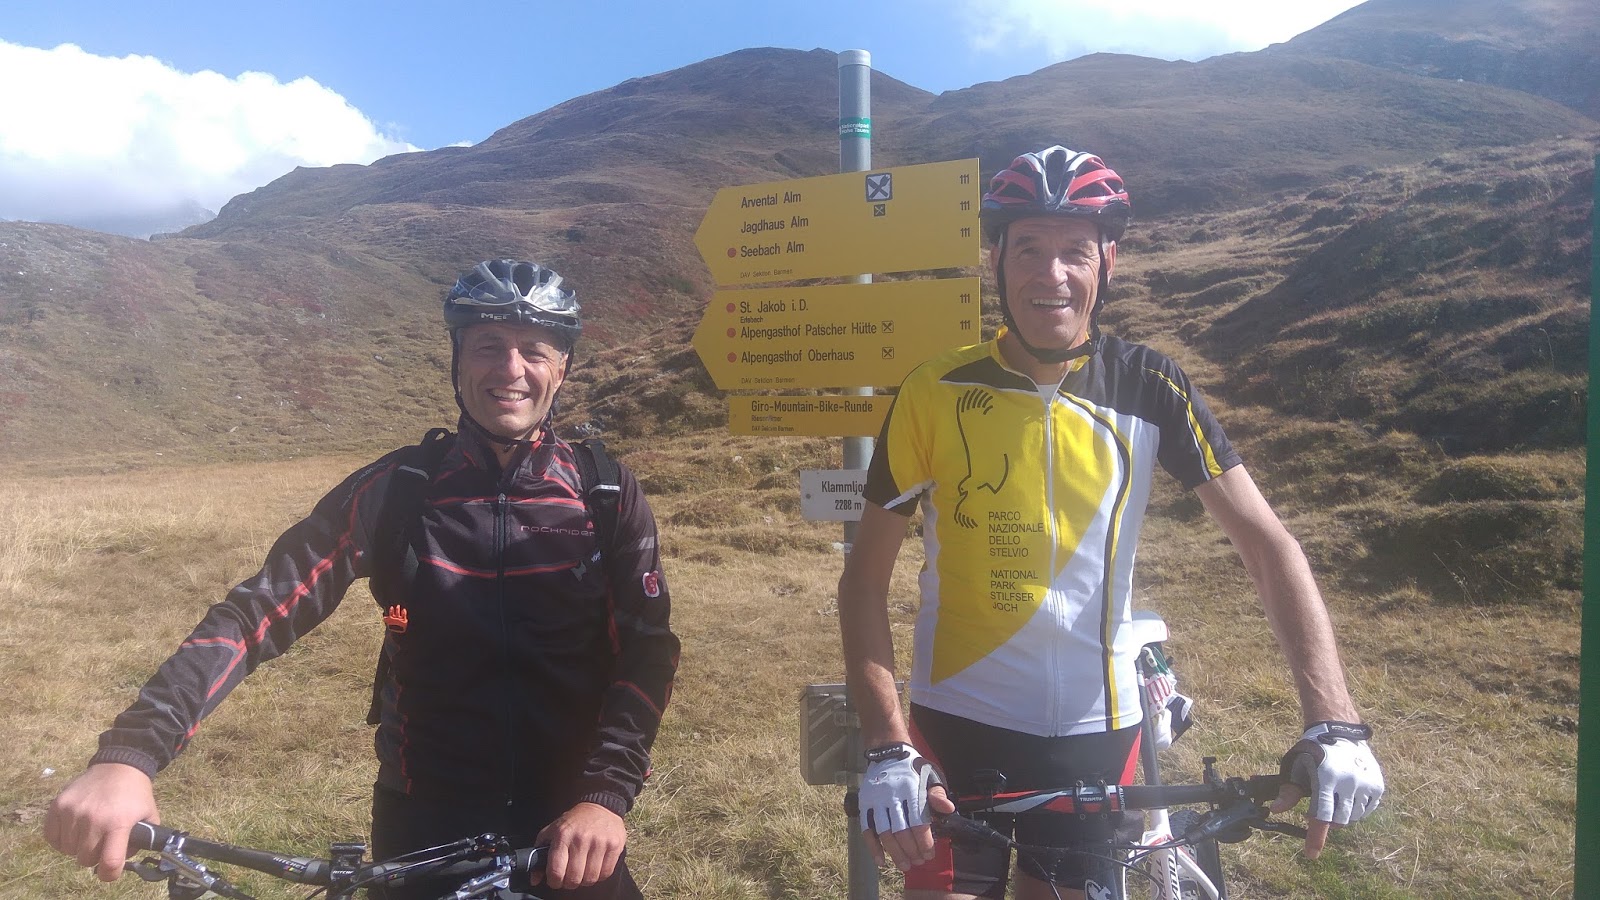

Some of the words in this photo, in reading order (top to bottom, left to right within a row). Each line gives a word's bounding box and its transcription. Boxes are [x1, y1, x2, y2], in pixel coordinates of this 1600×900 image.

[741, 193, 778, 209] Arvental
[783, 191, 802, 204] Alm
[959, 173, 970, 185] 111
[740, 219, 785, 235] Jagdhaus
[790, 215, 809, 229] Alm
[959, 200, 970, 211] 111
[740, 242, 781, 258] Seebach
[786, 241, 805, 254] Alm
[959, 227, 970, 238] 111
[757, 300, 786, 313] Jakob
[799, 299, 809, 311] D.
[959, 293, 970, 304] 111
[740, 324, 801, 341] Alpengasthof
[805, 323, 847, 336] Patscher
[851, 320, 877, 335] Hütte
[959, 320, 970, 331] 111
[741, 350, 802, 365] Alpengasthof
[807, 349, 855, 363] Oberhaus
[751, 400, 873, 413] Giro-Mountain-Bike-Runde
[854, 502, 862, 511] m
[988, 511, 1021, 521] PARCO
[988, 522, 1044, 533] NAZIONALE
[989, 535, 1021, 545] DELLO
[989, 547, 1029, 558] STELVIO
[990, 569, 1039, 580] NATIONAL
[990, 580, 1016, 590] PARK
[990, 591, 1035, 602] STILFSER
[992, 602, 1019, 612] JOCH
